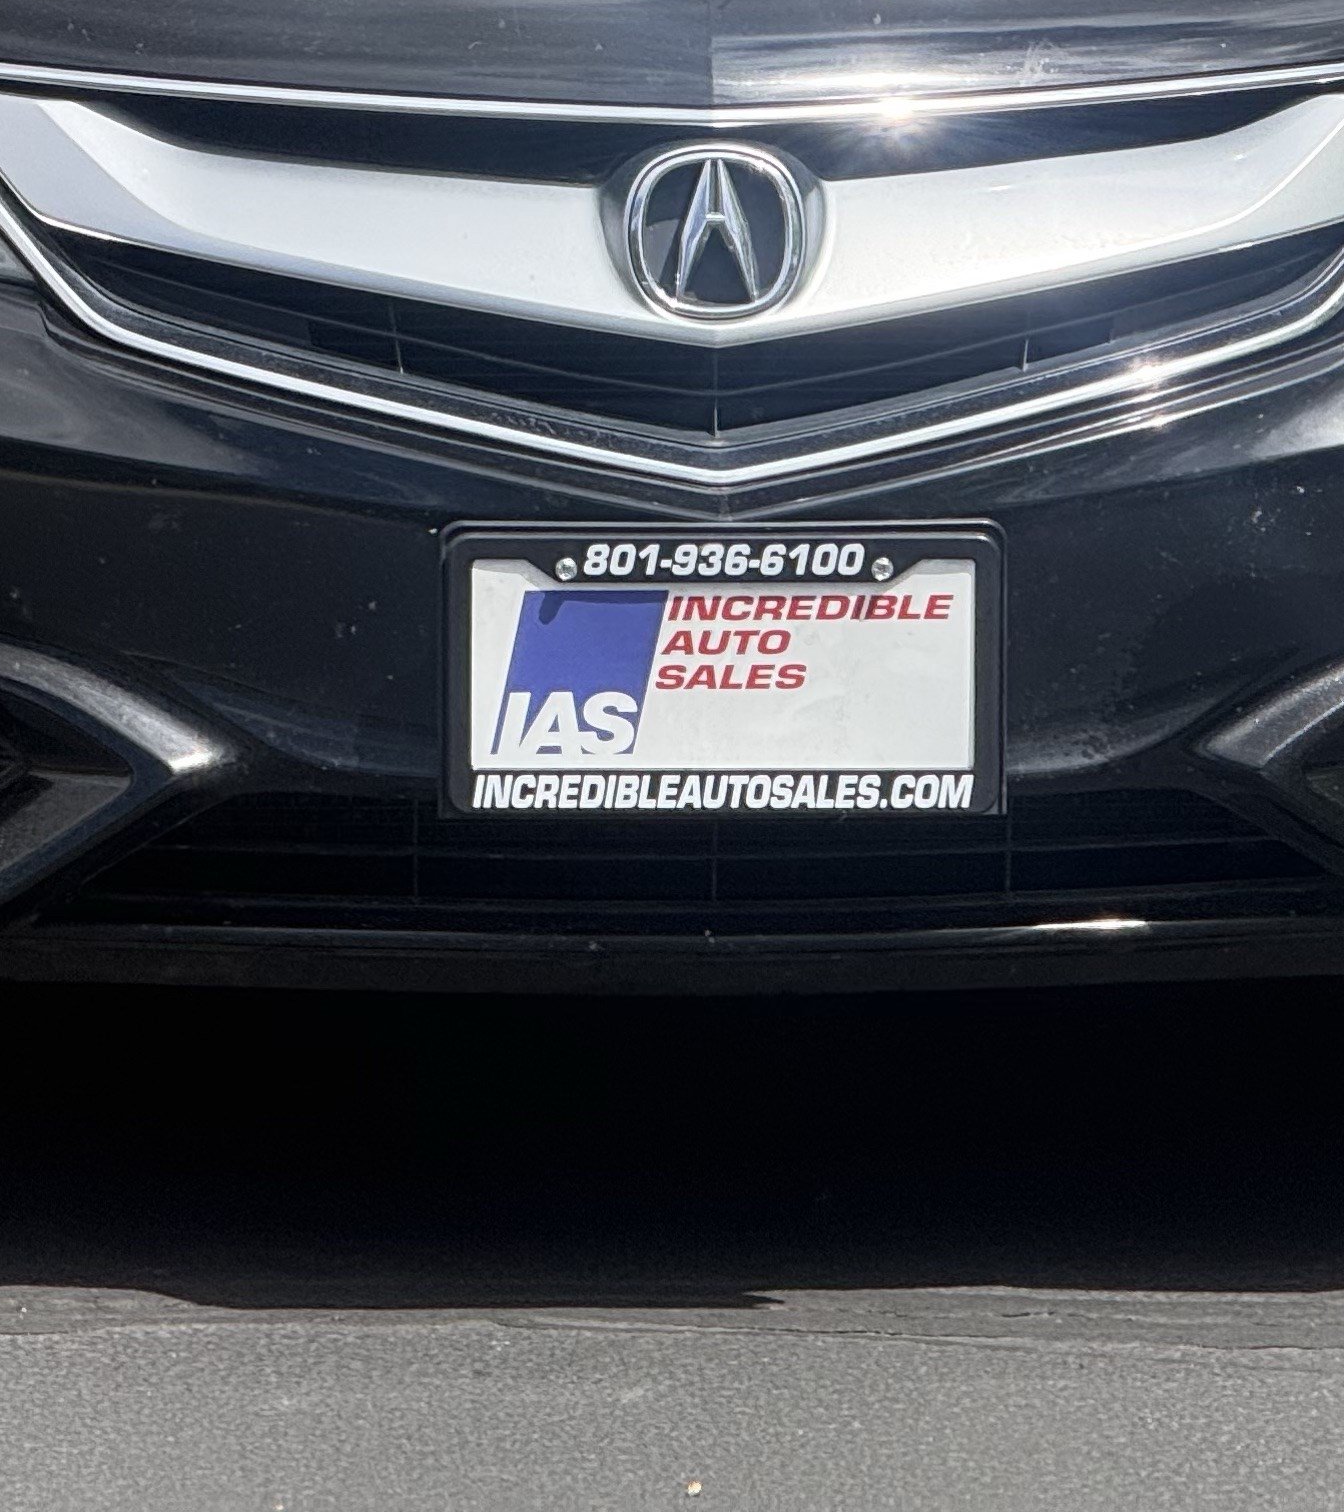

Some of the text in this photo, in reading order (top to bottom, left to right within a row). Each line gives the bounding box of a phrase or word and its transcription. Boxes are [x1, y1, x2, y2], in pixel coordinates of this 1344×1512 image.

[584, 544, 864, 576] 801-936-6100
[668, 595, 954, 620] INCREDIBLE
[662, 630, 791, 655] AUTO
[655, 664, 807, 689] SALES
[494, 691, 638, 754] IAS
[473, 774, 975, 809] INCREDIBLEAUTOSALES.COM
